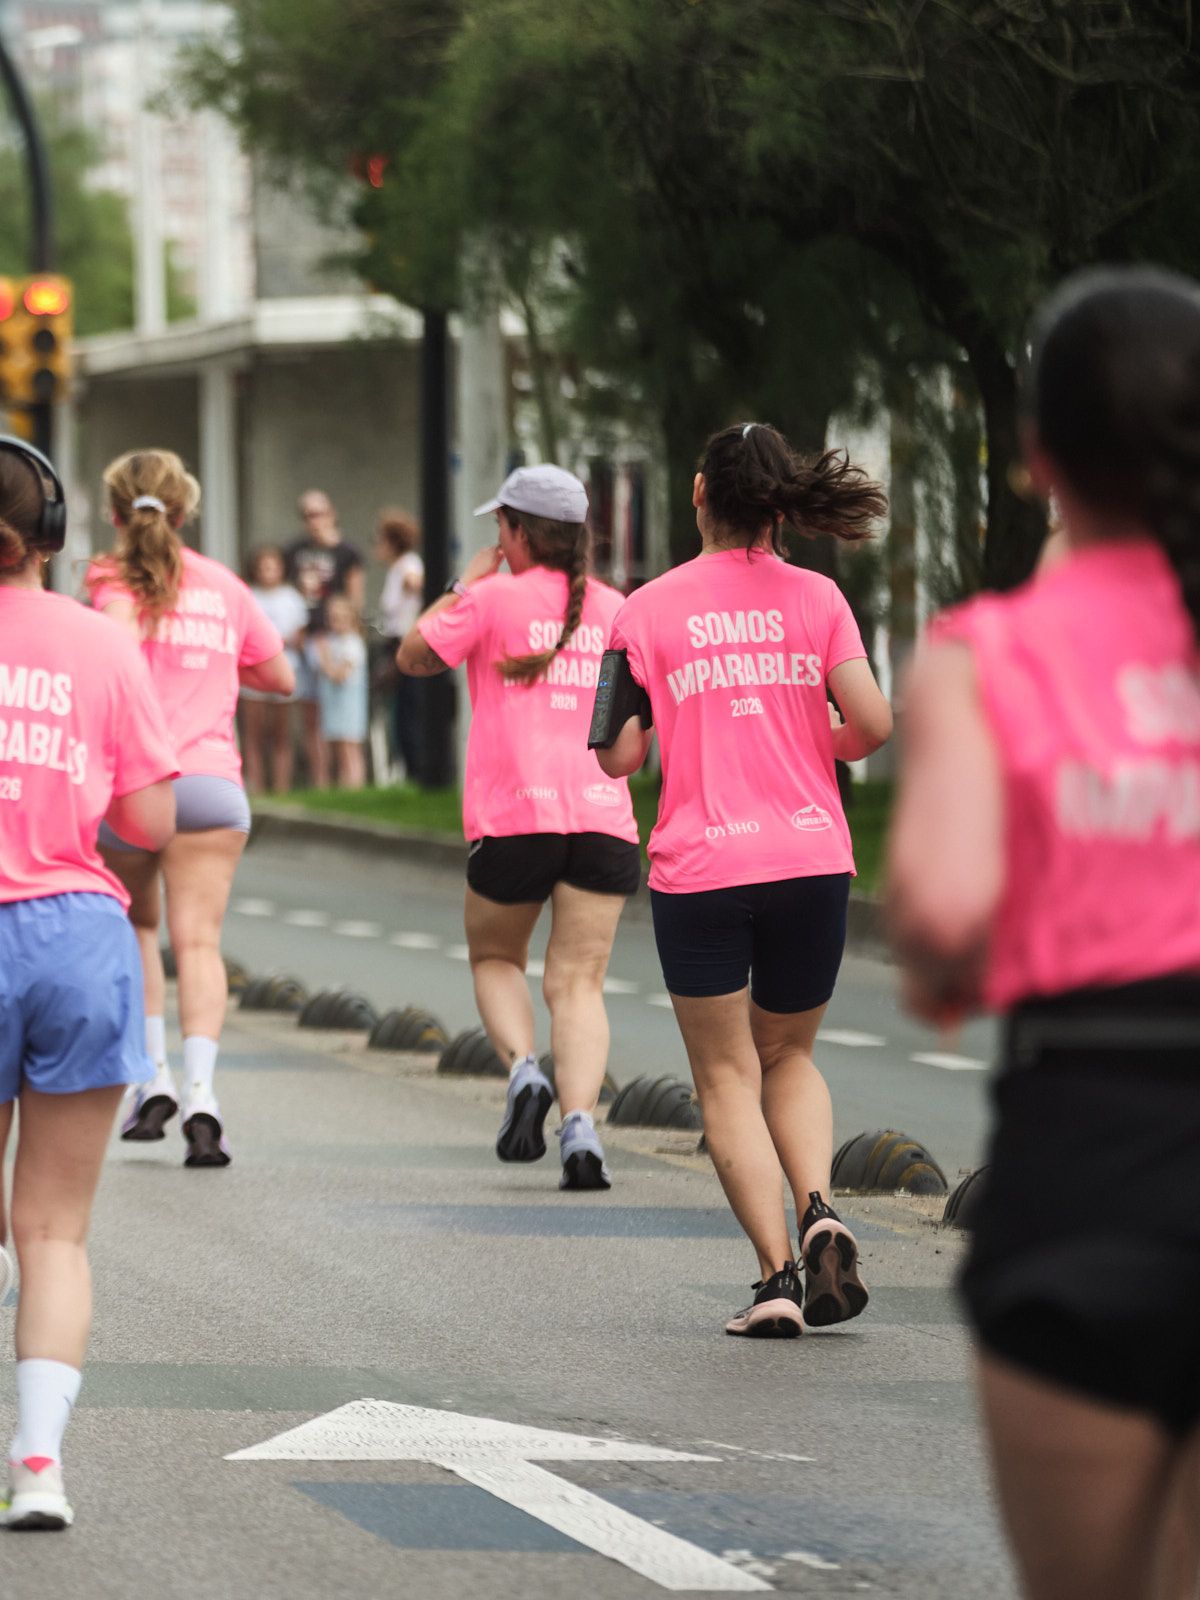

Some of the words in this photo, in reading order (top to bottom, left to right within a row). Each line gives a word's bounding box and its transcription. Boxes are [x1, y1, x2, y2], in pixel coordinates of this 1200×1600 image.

[687, 609, 785, 649] SOMOS
[666, 651, 822, 705] IMPARABLES
[705, 820, 760, 840] OYSHO
